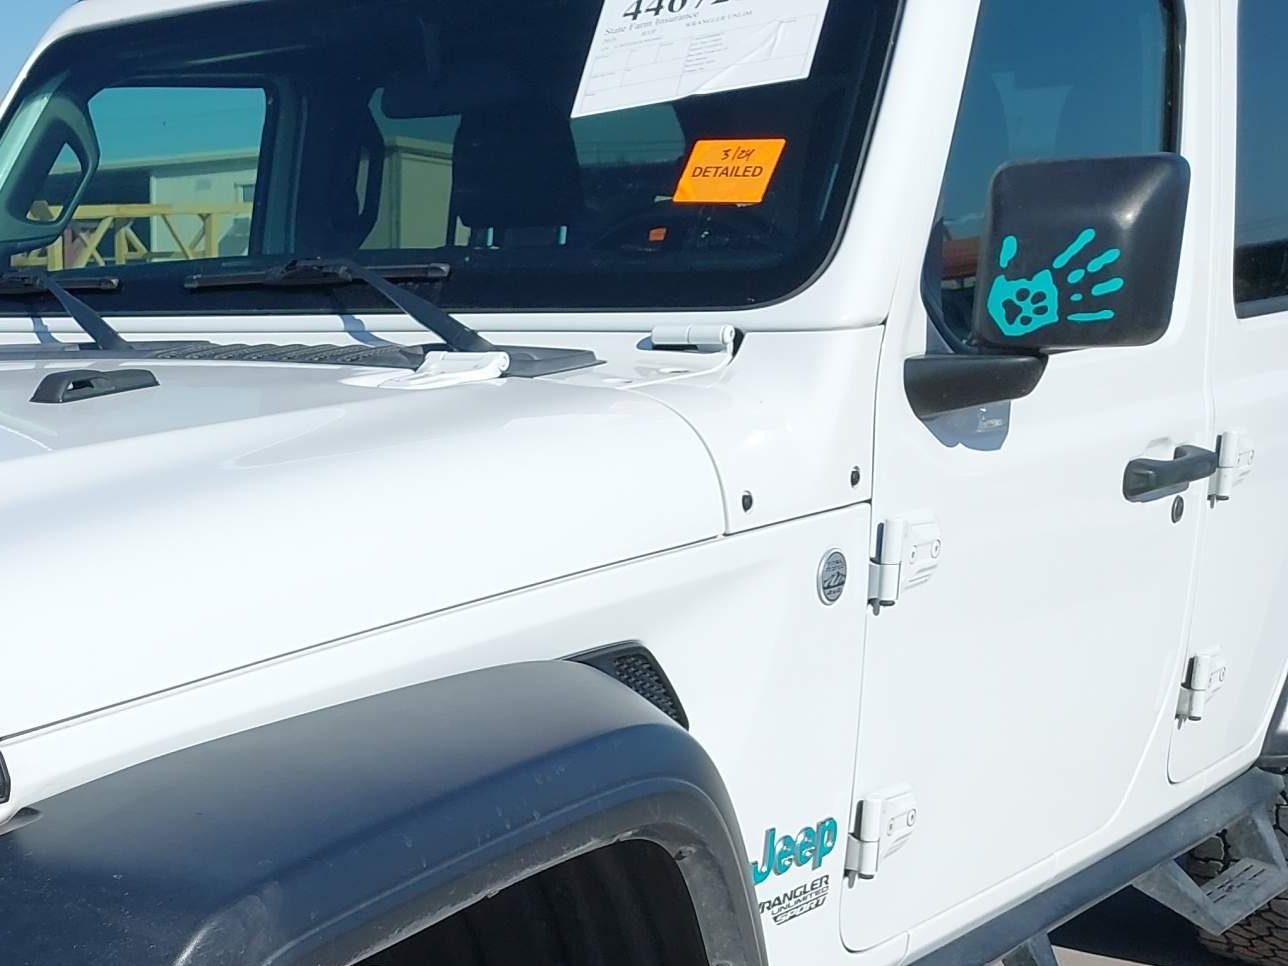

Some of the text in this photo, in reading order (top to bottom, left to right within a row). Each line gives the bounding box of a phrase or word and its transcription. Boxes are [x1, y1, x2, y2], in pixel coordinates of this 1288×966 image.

[691, 165, 764, 178] DETAILED
[750, 817, 838, 886] Jeep
[771, 885, 830, 916] UNLIMITED
